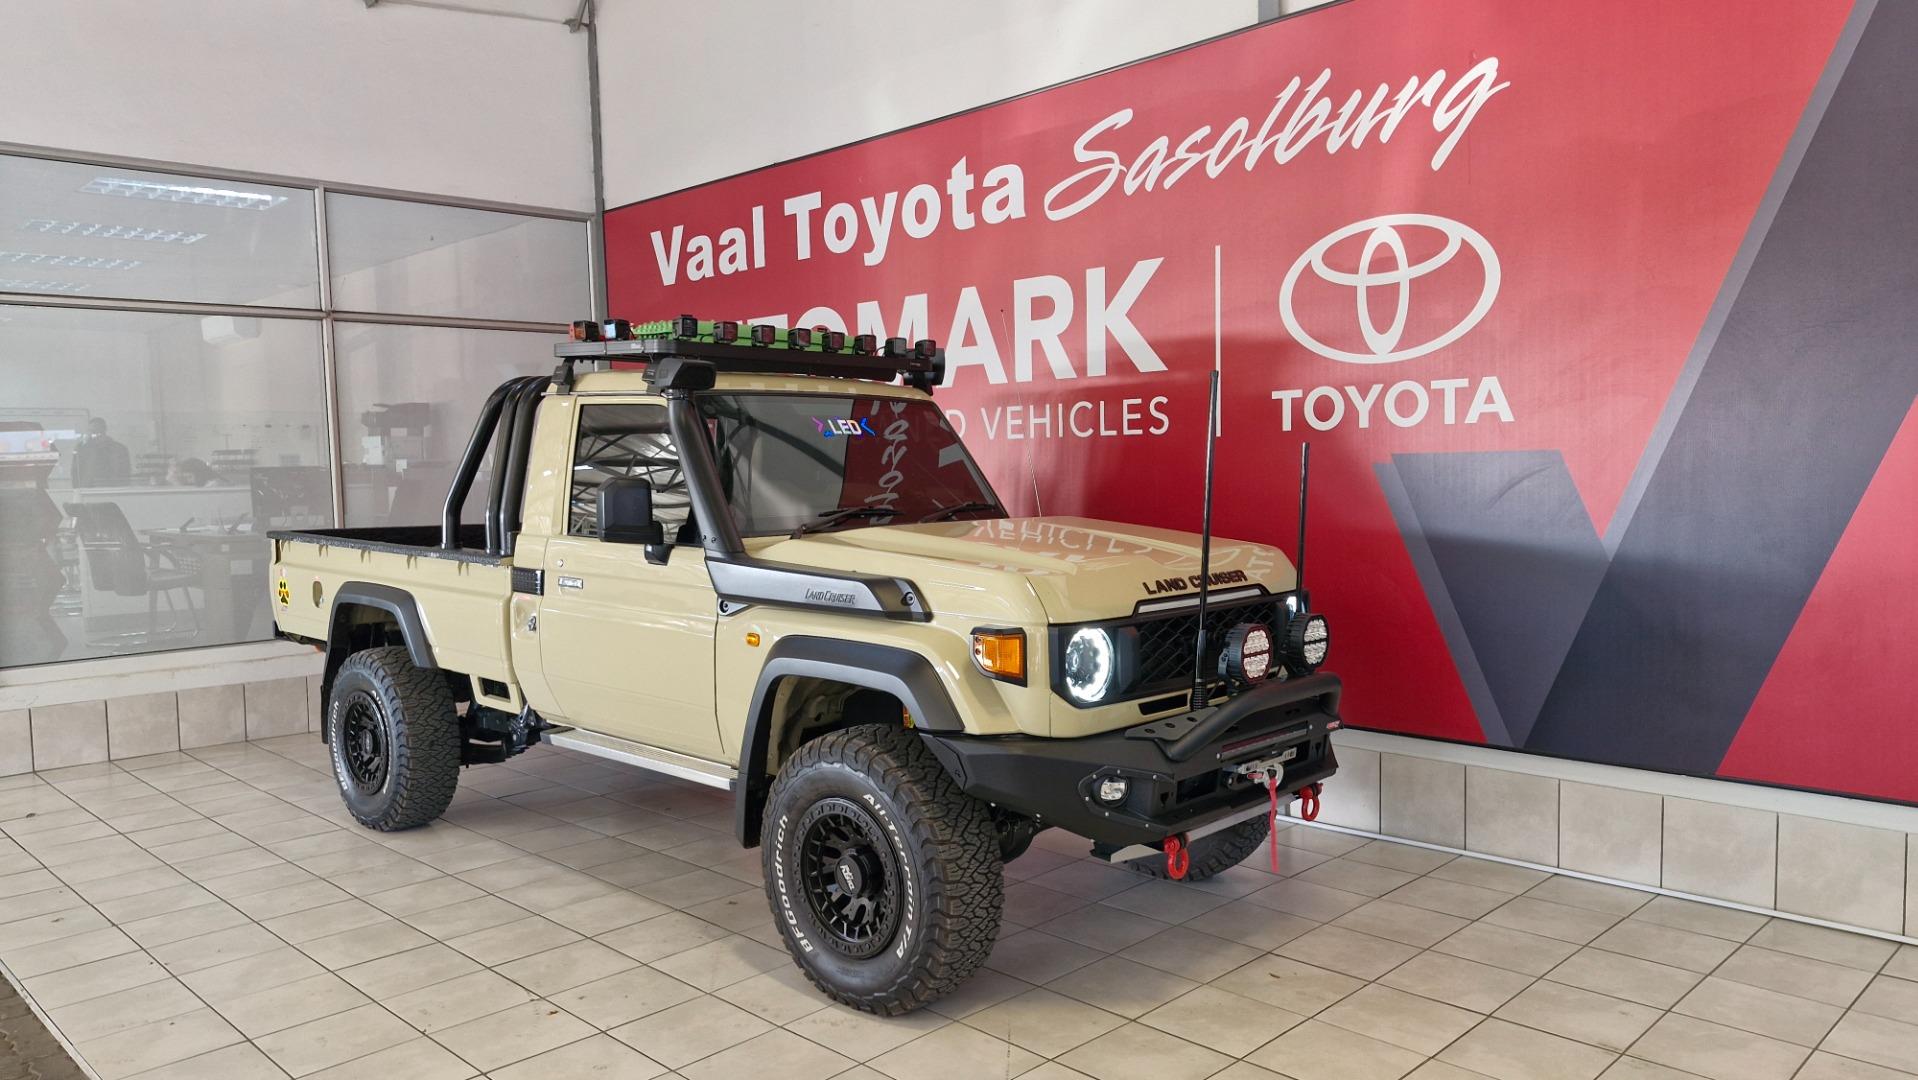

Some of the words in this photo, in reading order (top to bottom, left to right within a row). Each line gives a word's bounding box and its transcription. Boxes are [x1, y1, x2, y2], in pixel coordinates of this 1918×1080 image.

[650, 205, 765, 286] Vaal
[784, 155, 1026, 266] Toyota
[1043, 56, 1511, 222] Sasolburg
[827, 418, 862, 435] LED
[980, 396, 1169, 441] VEHICLES
[1271, 375, 1516, 431] TOYOTA
[1142, 576, 1188, 595] LAND
[1188, 569, 1248, 588] CUISER
[774, 814, 814, 953] BFGoodrich
[863, 793, 914, 921] All-Terrain
[895, 924, 913, 959] T/A
